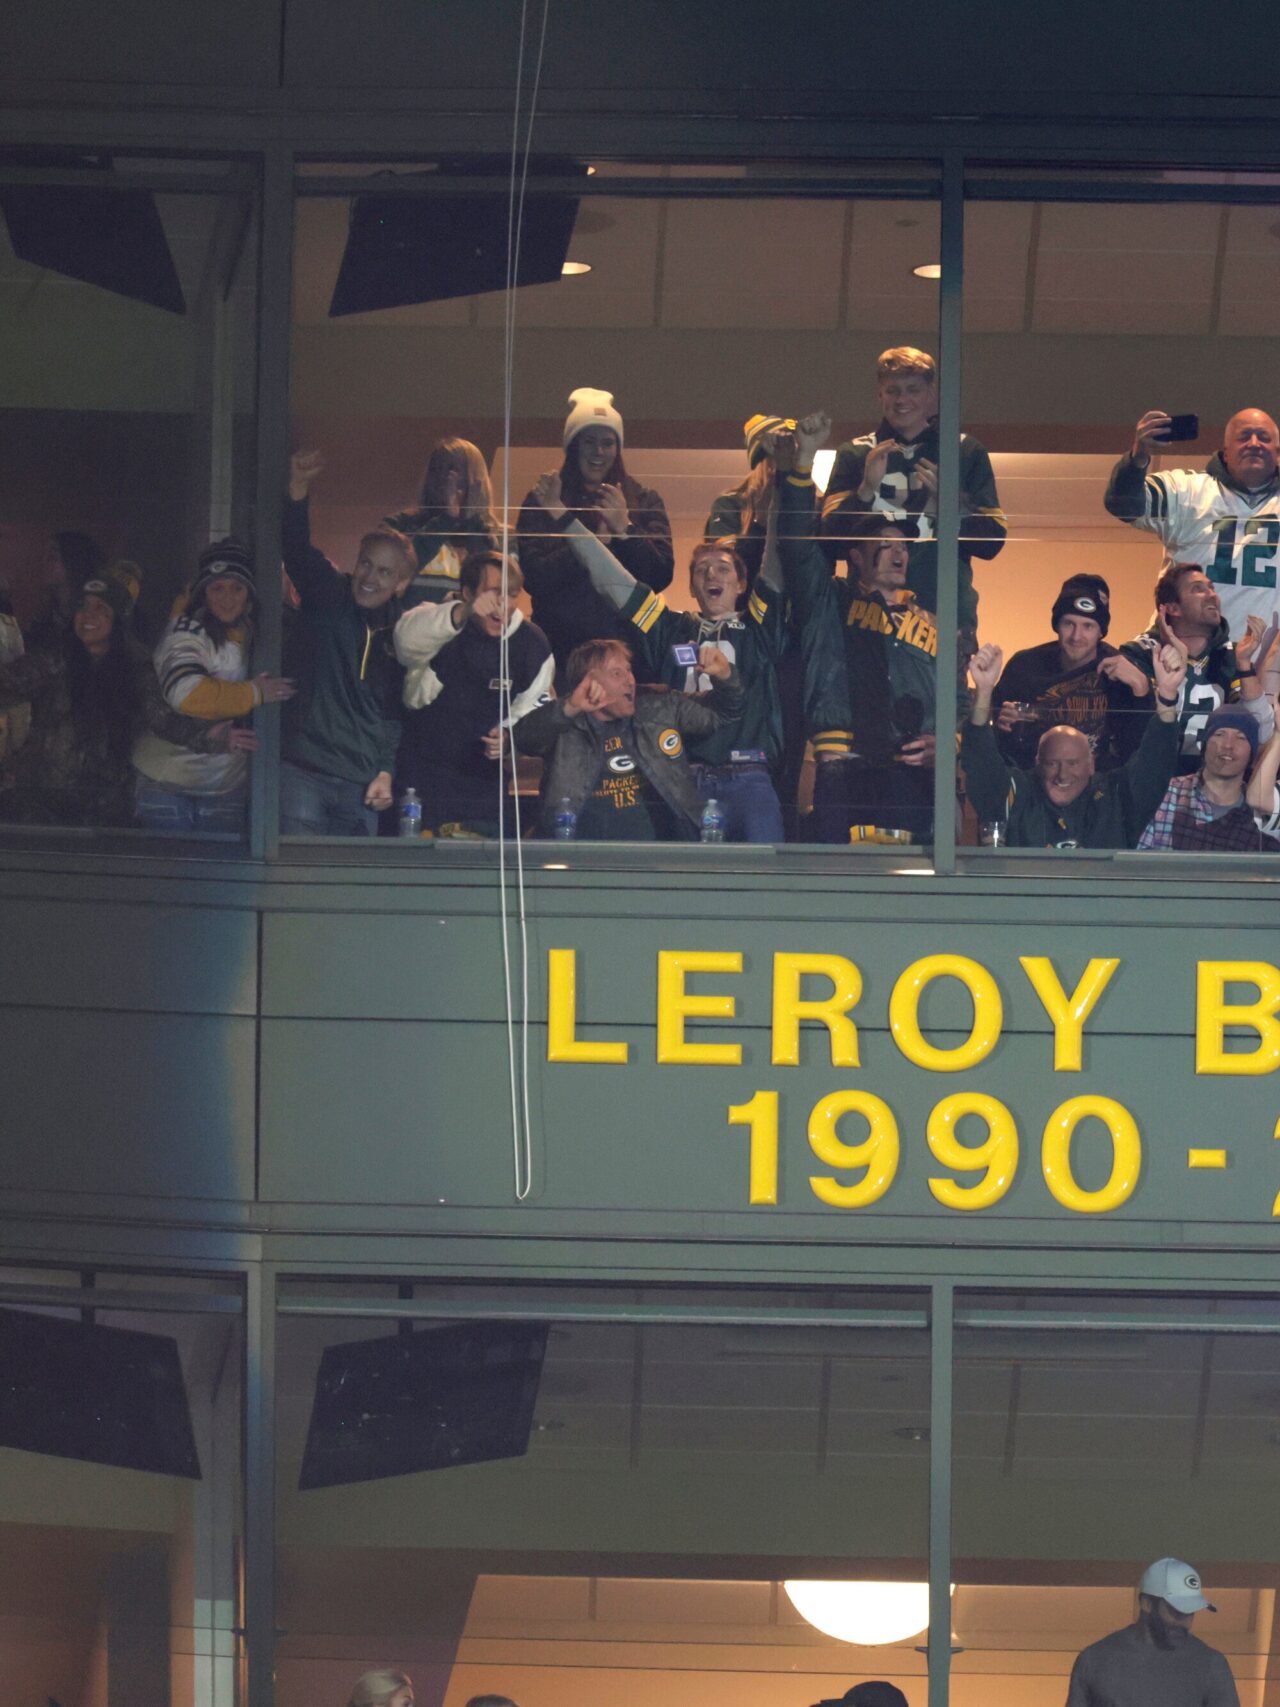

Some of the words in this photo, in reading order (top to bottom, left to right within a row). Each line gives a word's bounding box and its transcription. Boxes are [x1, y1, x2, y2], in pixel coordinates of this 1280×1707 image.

[1206, 513, 1280, 588] 12
[546, 947, 1121, 1076] LEROY
[726, 1088, 1143, 1216] 1990
[1187, 1148, 1227, 1169] -
